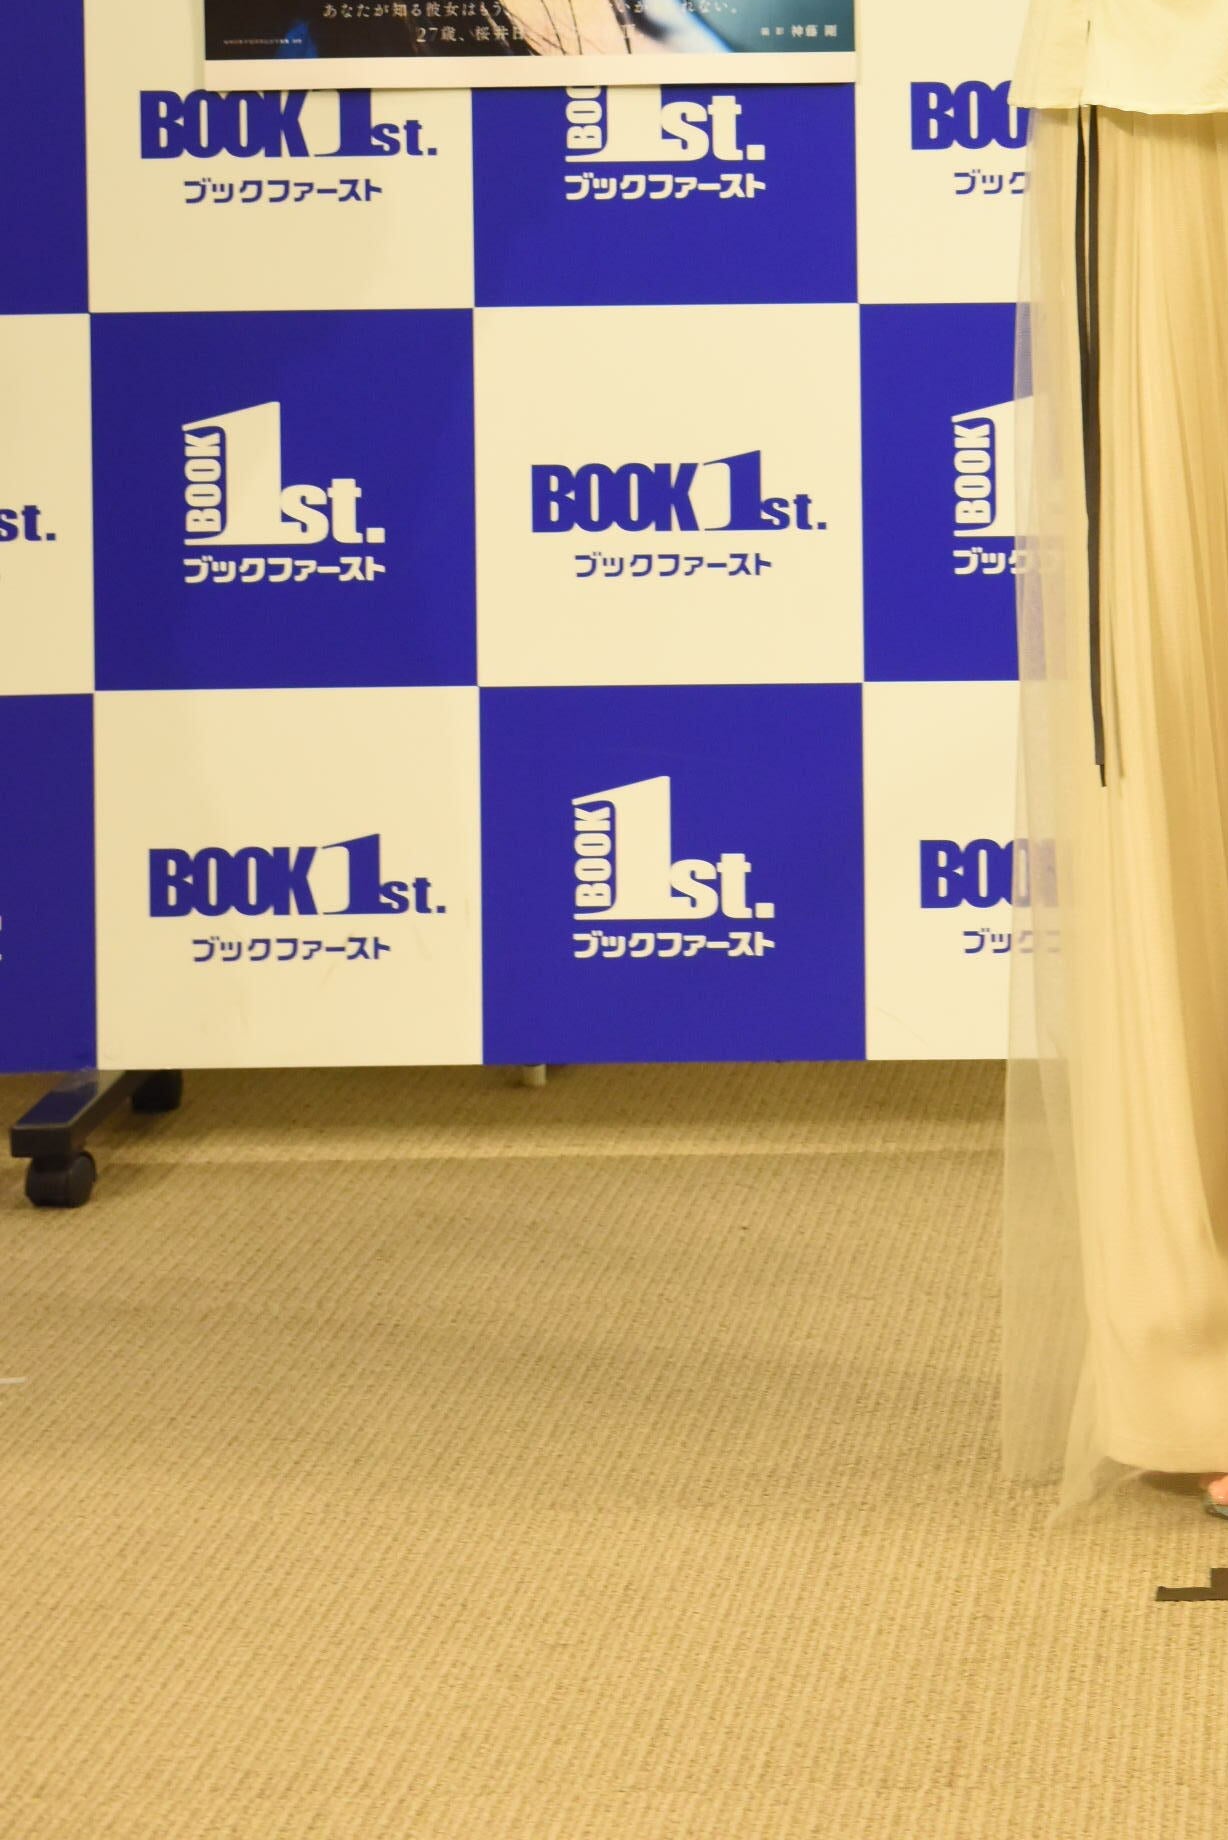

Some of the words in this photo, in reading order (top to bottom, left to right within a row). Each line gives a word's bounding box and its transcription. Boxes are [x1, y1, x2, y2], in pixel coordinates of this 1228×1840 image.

[911, 79, 1030, 150] BOO
[185, 179, 382, 205] ブックファースト
[564, 174, 766, 201] ブックファースト
[954, 423, 992, 524] BOOK
[183, 557, 386, 584] ブックファースト
[574, 553, 772, 580] ブックファースト
[193, 937, 391, 963] ブックファースト
[573, 932, 775, 959] ブックファースト
